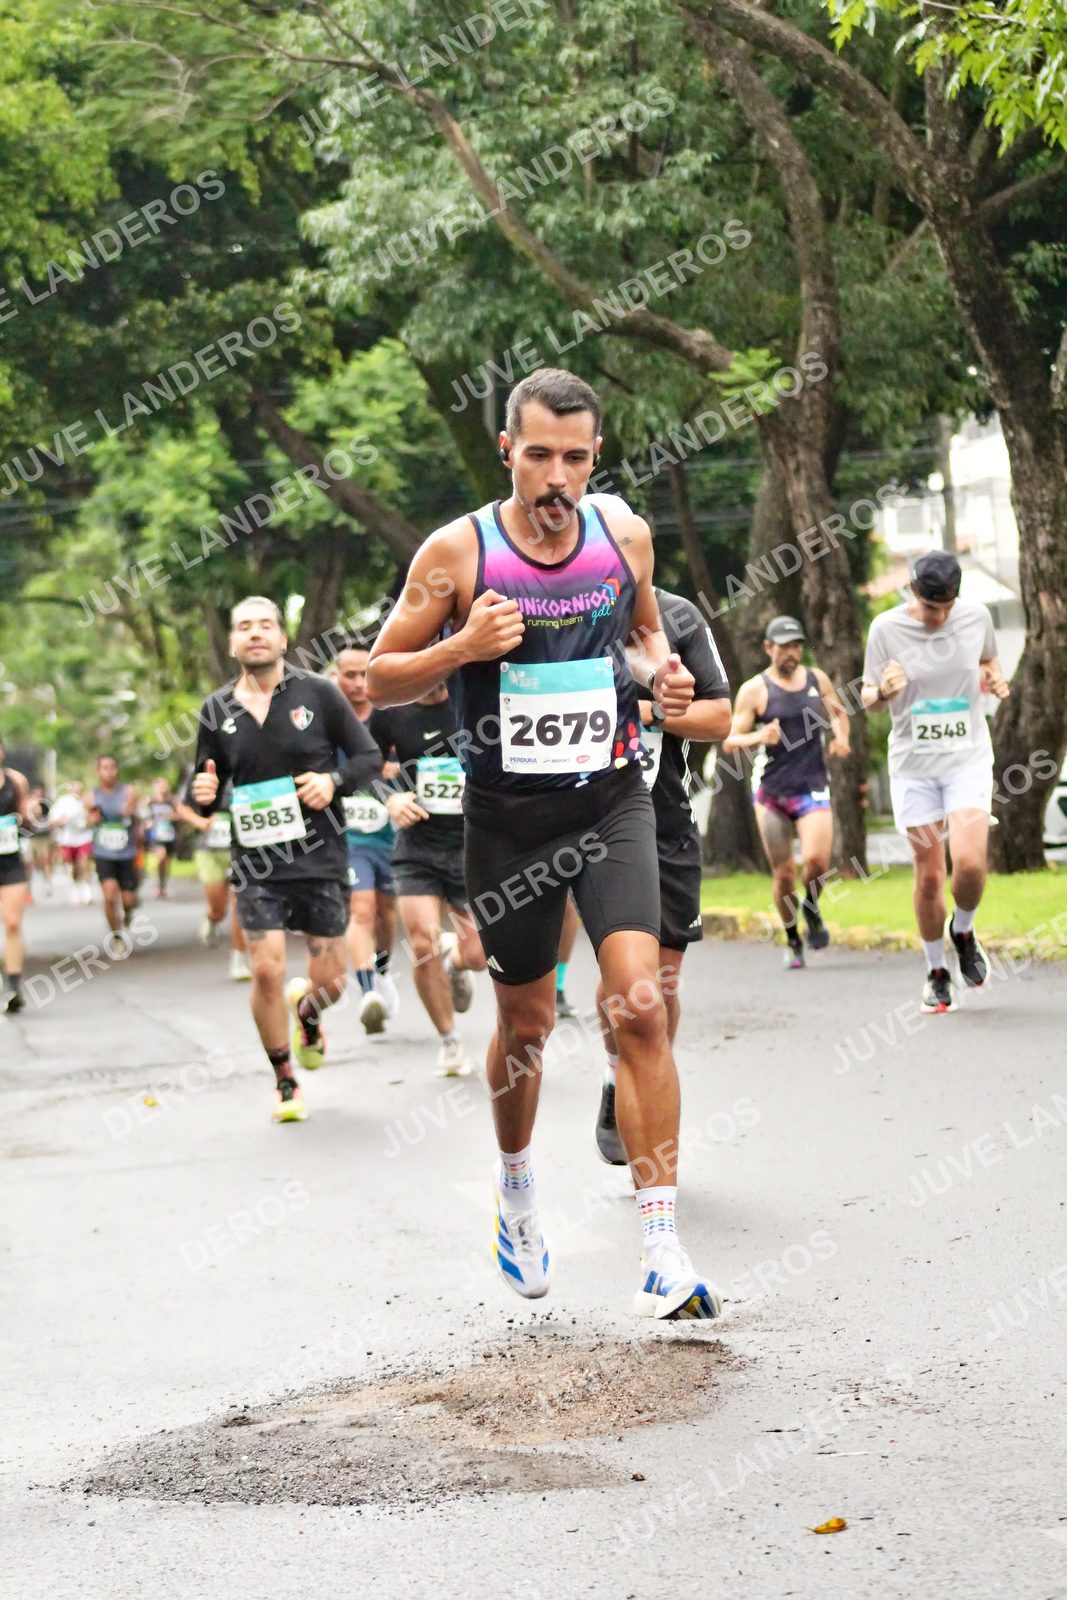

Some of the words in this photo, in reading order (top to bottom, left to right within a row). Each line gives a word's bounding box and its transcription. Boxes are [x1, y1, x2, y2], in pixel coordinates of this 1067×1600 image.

[528, 619, 559, 629] running
[560, 615, 583, 627] team
[509, 710, 611, 747] 2679
[917, 721, 966, 740] 2548
[240, 806, 296, 832] 5983
